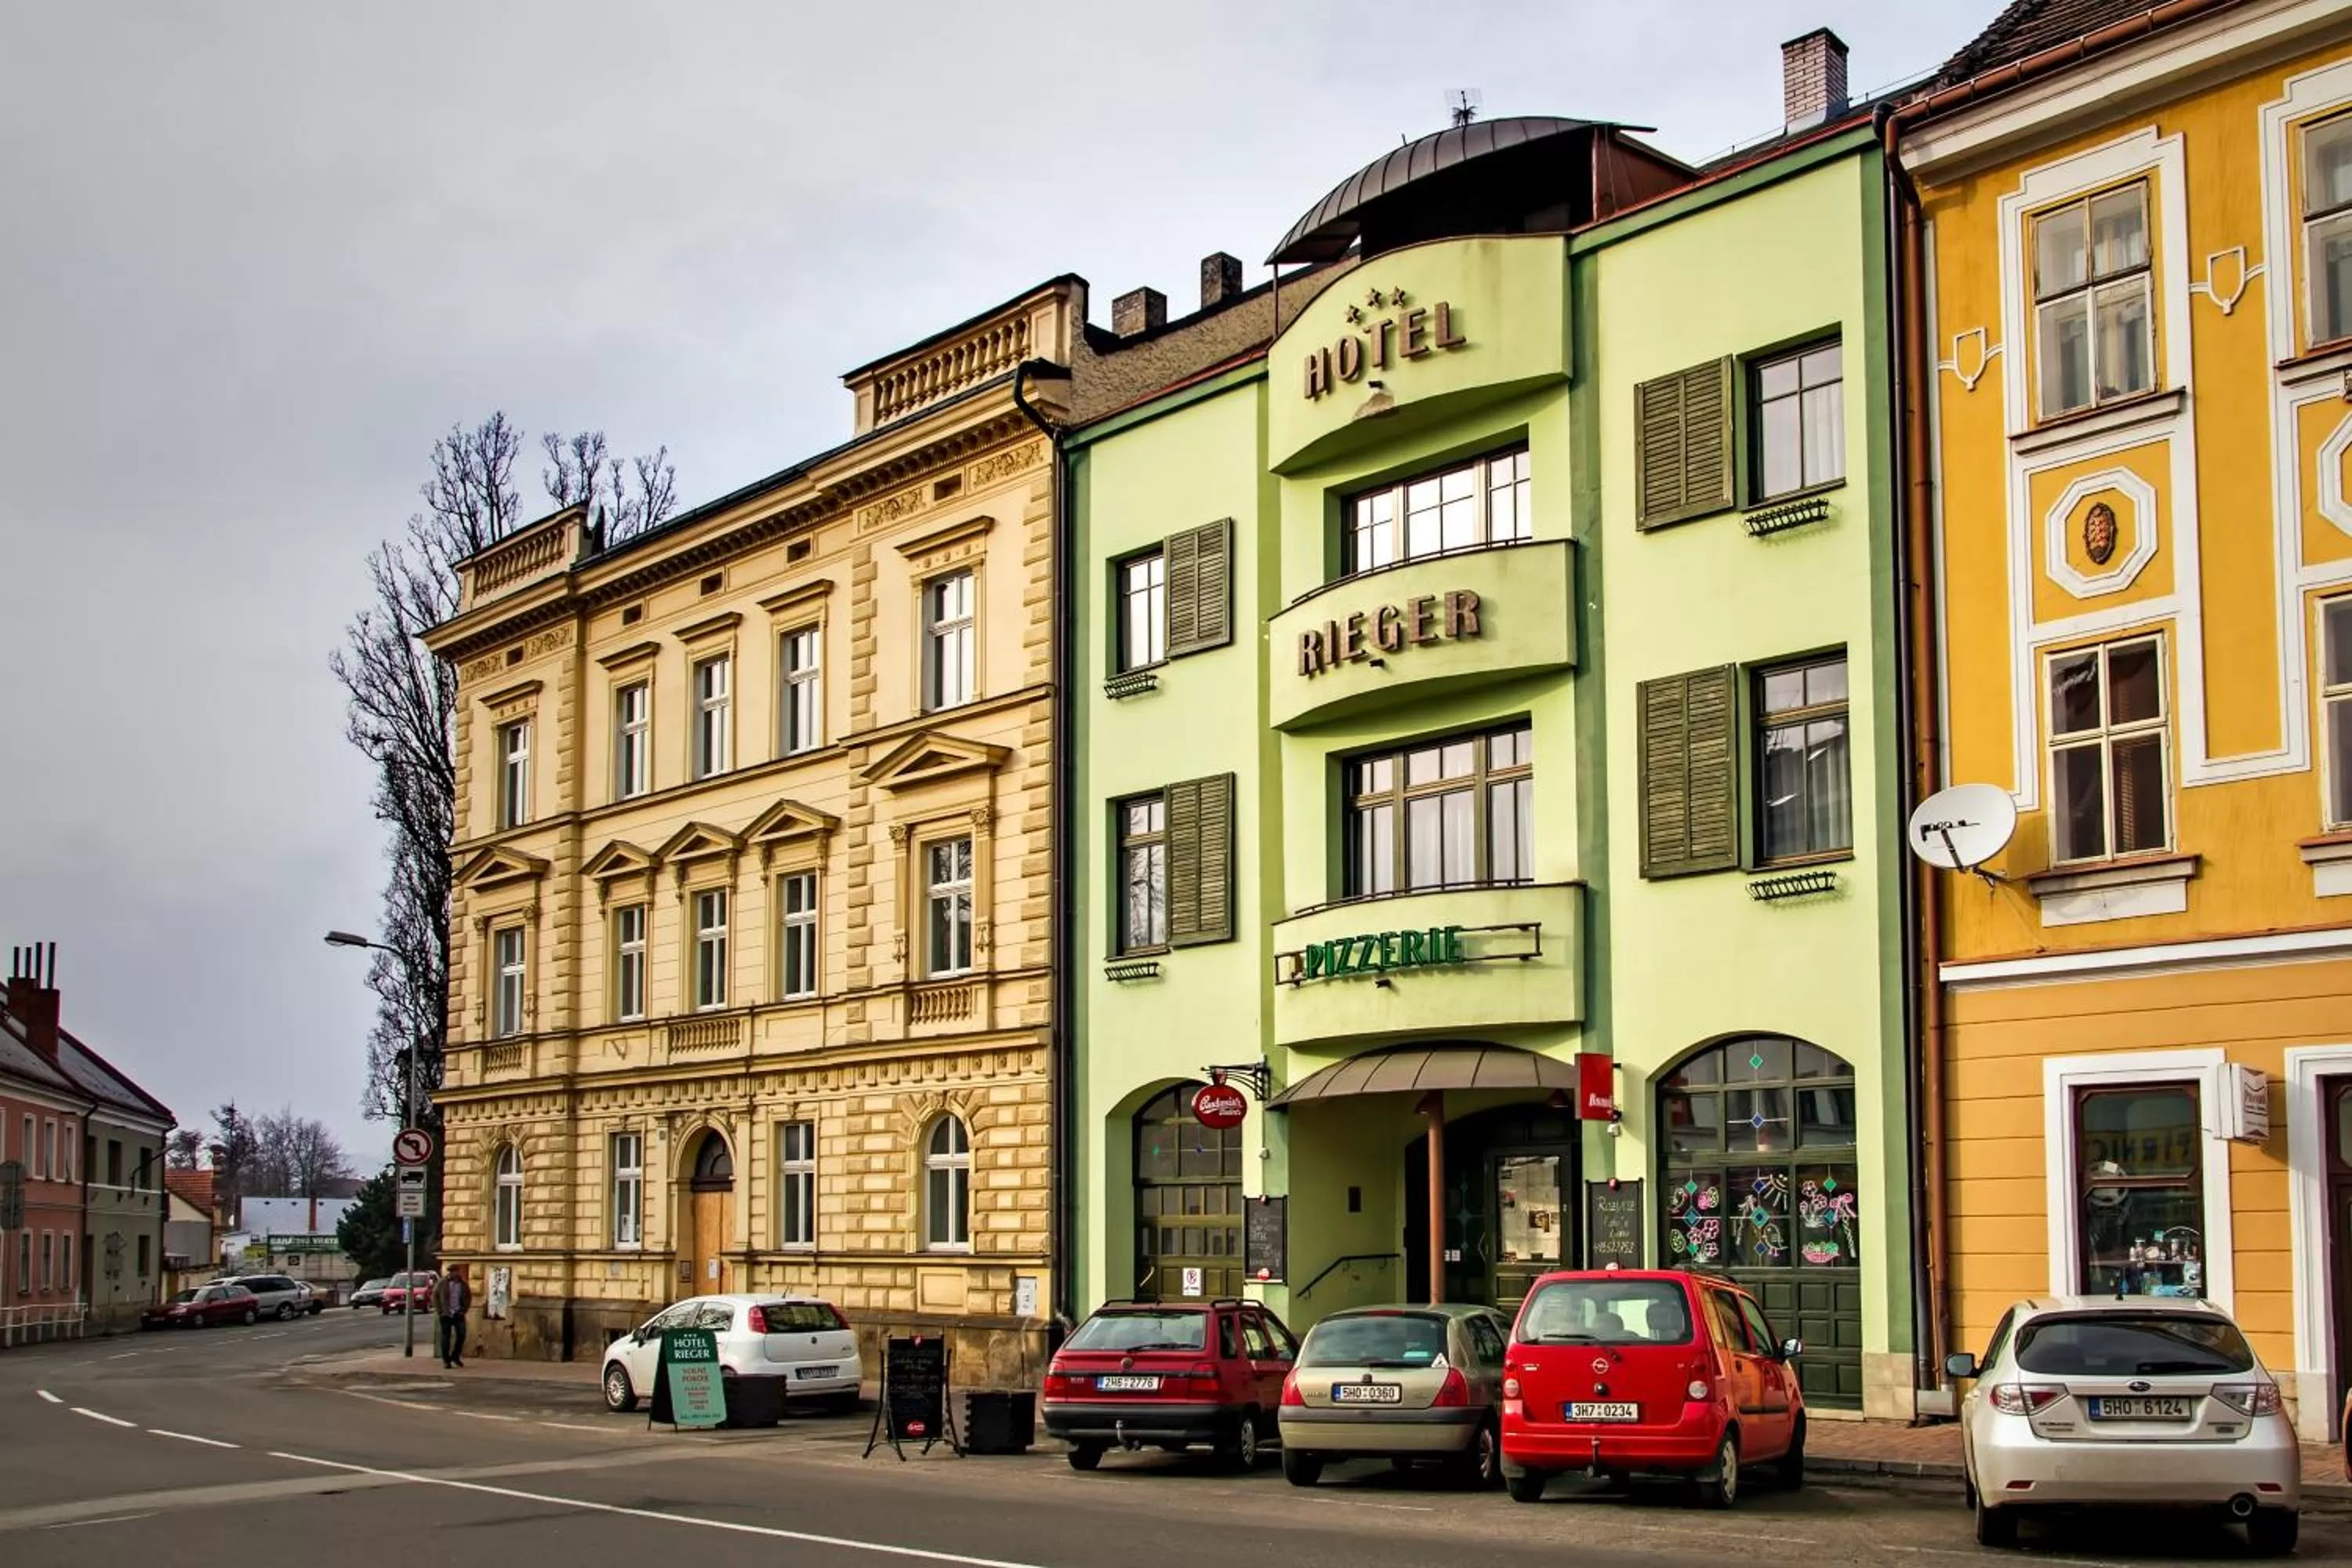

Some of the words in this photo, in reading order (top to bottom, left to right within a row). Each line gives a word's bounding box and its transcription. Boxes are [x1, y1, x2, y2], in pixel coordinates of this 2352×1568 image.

[1305, 301, 1466, 399] HOTEL
[1298, 590, 1480, 677] RIEGER
[1306, 925, 1463, 979] PIZZERIE
[674, 1338, 707, 1348] HOTEL
[675, 1349, 710, 1359] RIEGER
[1575, 1405, 1595, 1416] 3H7
[1604, 1405, 1632, 1417] 0234
[2145, 1399, 2183, 1415] 6124
